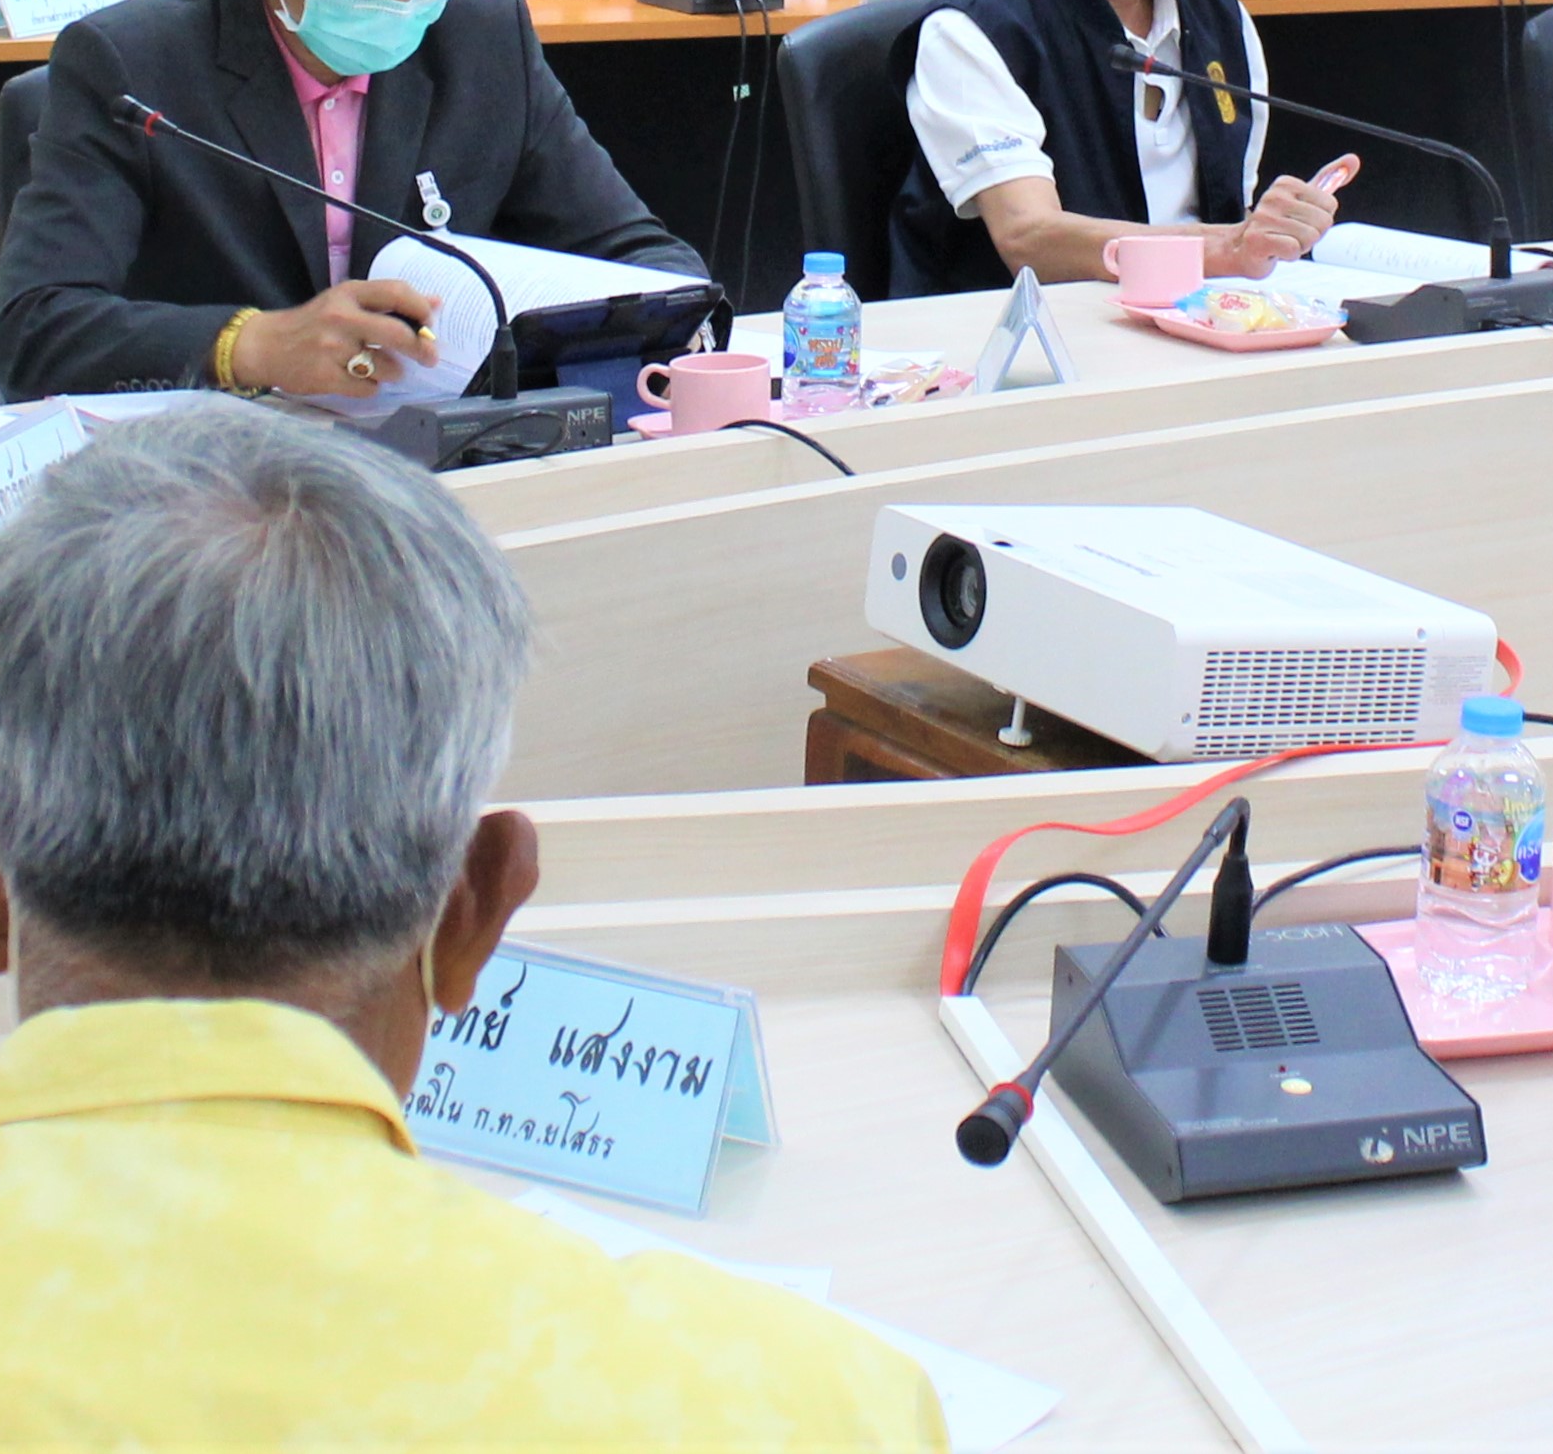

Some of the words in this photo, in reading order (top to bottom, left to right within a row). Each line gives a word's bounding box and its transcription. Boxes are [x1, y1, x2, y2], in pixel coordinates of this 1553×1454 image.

[567, 407, 605, 422] NPE
[549, 997, 713, 1098] แสงงาม
[1402, 1121, 1471, 1148] NPE
